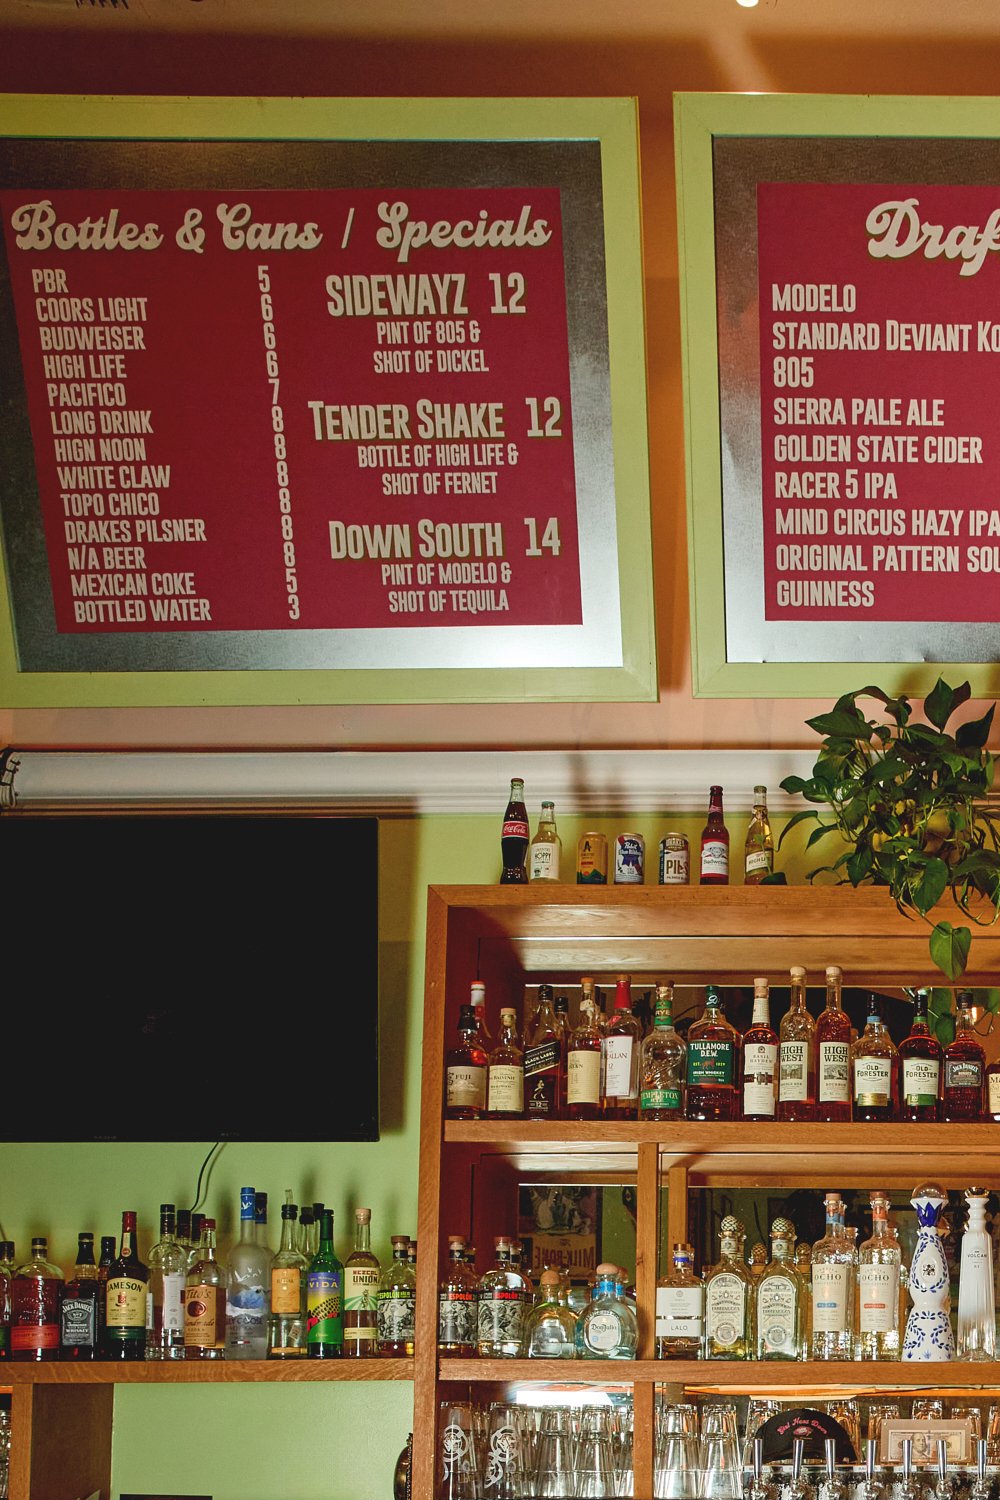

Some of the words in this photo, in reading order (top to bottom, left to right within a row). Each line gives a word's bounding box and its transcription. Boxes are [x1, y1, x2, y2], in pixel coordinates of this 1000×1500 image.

[12, 200, 164, 250] Bottles
[176, 208, 205, 253] &
[217, 204, 323, 250] Cans
[342, 208, 354, 248] /
[376, 202, 552, 262] Specials
[32, 269, 68, 292] PBR
[326, 274, 468, 316] SIDEWAYZ
[489, 272, 526, 313] 12
[772, 284, 856, 312] MODELO
[36, 298, 94, 322] COORS
[98, 298, 147, 321] LIGHT
[40, 326, 146, 350] BUDWEISER
[377, 322, 409, 344] PINT
[414, 321, 431, 344] OF
[436, 321, 465, 343] 805
[470, 320, 480, 342] &
[773, 322, 879, 350] STANDARD
[886, 320, 972, 351] DEVIANT
[44, 355, 85, 378] HIGH
[89, 355, 127, 378] LIFE
[374, 351, 410, 373] SHOT
[415, 350, 432, 372] OF
[437, 350, 489, 372] DICKEL
[774, 356, 813, 387] 805
[47, 383, 126, 406] PACIFICO
[51, 411, 96, 434] LONG
[100, 410, 153, 434] DRINK
[308, 401, 412, 440] TENDER
[417, 399, 504, 439] SHAKE
[526, 397, 562, 436] 12
[774, 398, 846, 424] SIERRA
[852, 399, 901, 425] PALE
[907, 399, 944, 426] ALE
[54, 439, 96, 462] HIGN
[100, 438, 146, 461] NOON
[358, 445, 410, 467] BOTTLE
[414, 445, 431, 466] OF
[436, 444, 470, 466] HIGH
[474, 444, 504, 465] LIFE
[508, 443, 518, 464] &
[775, 435, 850, 462] GOLDEN
[857, 436, 918, 462] STATE
[924, 436, 983, 463] CIDER
[57, 466, 116, 489] WHITE
[119, 465, 170, 488] CLAW
[382, 473, 418, 495] SHOT
[423, 473, 440, 494] OF
[445, 472, 498, 494] FERNET
[776, 472, 840, 498] RACER
[846, 469, 858, 498] 5
[865, 473, 898, 499] IPA
[60, 494, 104, 516] TOPO
[109, 493, 159, 516] CHICO
[64, 520, 131, 543] DRAKES
[136, 519, 207, 542] PILSNER
[776, 509, 828, 534] MIND
[834, 509, 905, 535] CIRCUS
[912, 510, 963, 536] HAZY
[329, 521, 411, 559] DOWN
[418, 519, 502, 557] SOUTH
[524, 518, 560, 556] 14
[68, 545, 100, 570] N/A
[103, 547, 146, 569] BEER
[776, 545, 867, 570] ORIGINAL
[873, 546, 959, 572] PATTERN
[71, 574, 148, 596] MEXICAN
[152, 573, 196, 595] COKE
[382, 564, 413, 585] PINT
[417, 564, 434, 584] OF
[438, 562, 497, 584] MODELO
[501, 562, 512, 583] &
[389, 591, 425, 612] SHOT
[429, 590, 446, 612] OF
[450, 590, 509, 614] TEQUILA
[777, 580, 874, 606] GUINNESS
[74, 600, 146, 622] BOTTLED
[149, 599, 212, 621] WATER
[540, 1051, 555, 1060] LABEL
[781, 1046, 803, 1054] HIGH
[781, 1054, 803, 1062] WEST
[824, 1046, 848, 1054] HIGH
[824, 1054, 848, 1062] WEST
[857, 1070, 889, 1078] FORESTER
[108, 1281, 142, 1292] JAMESON
